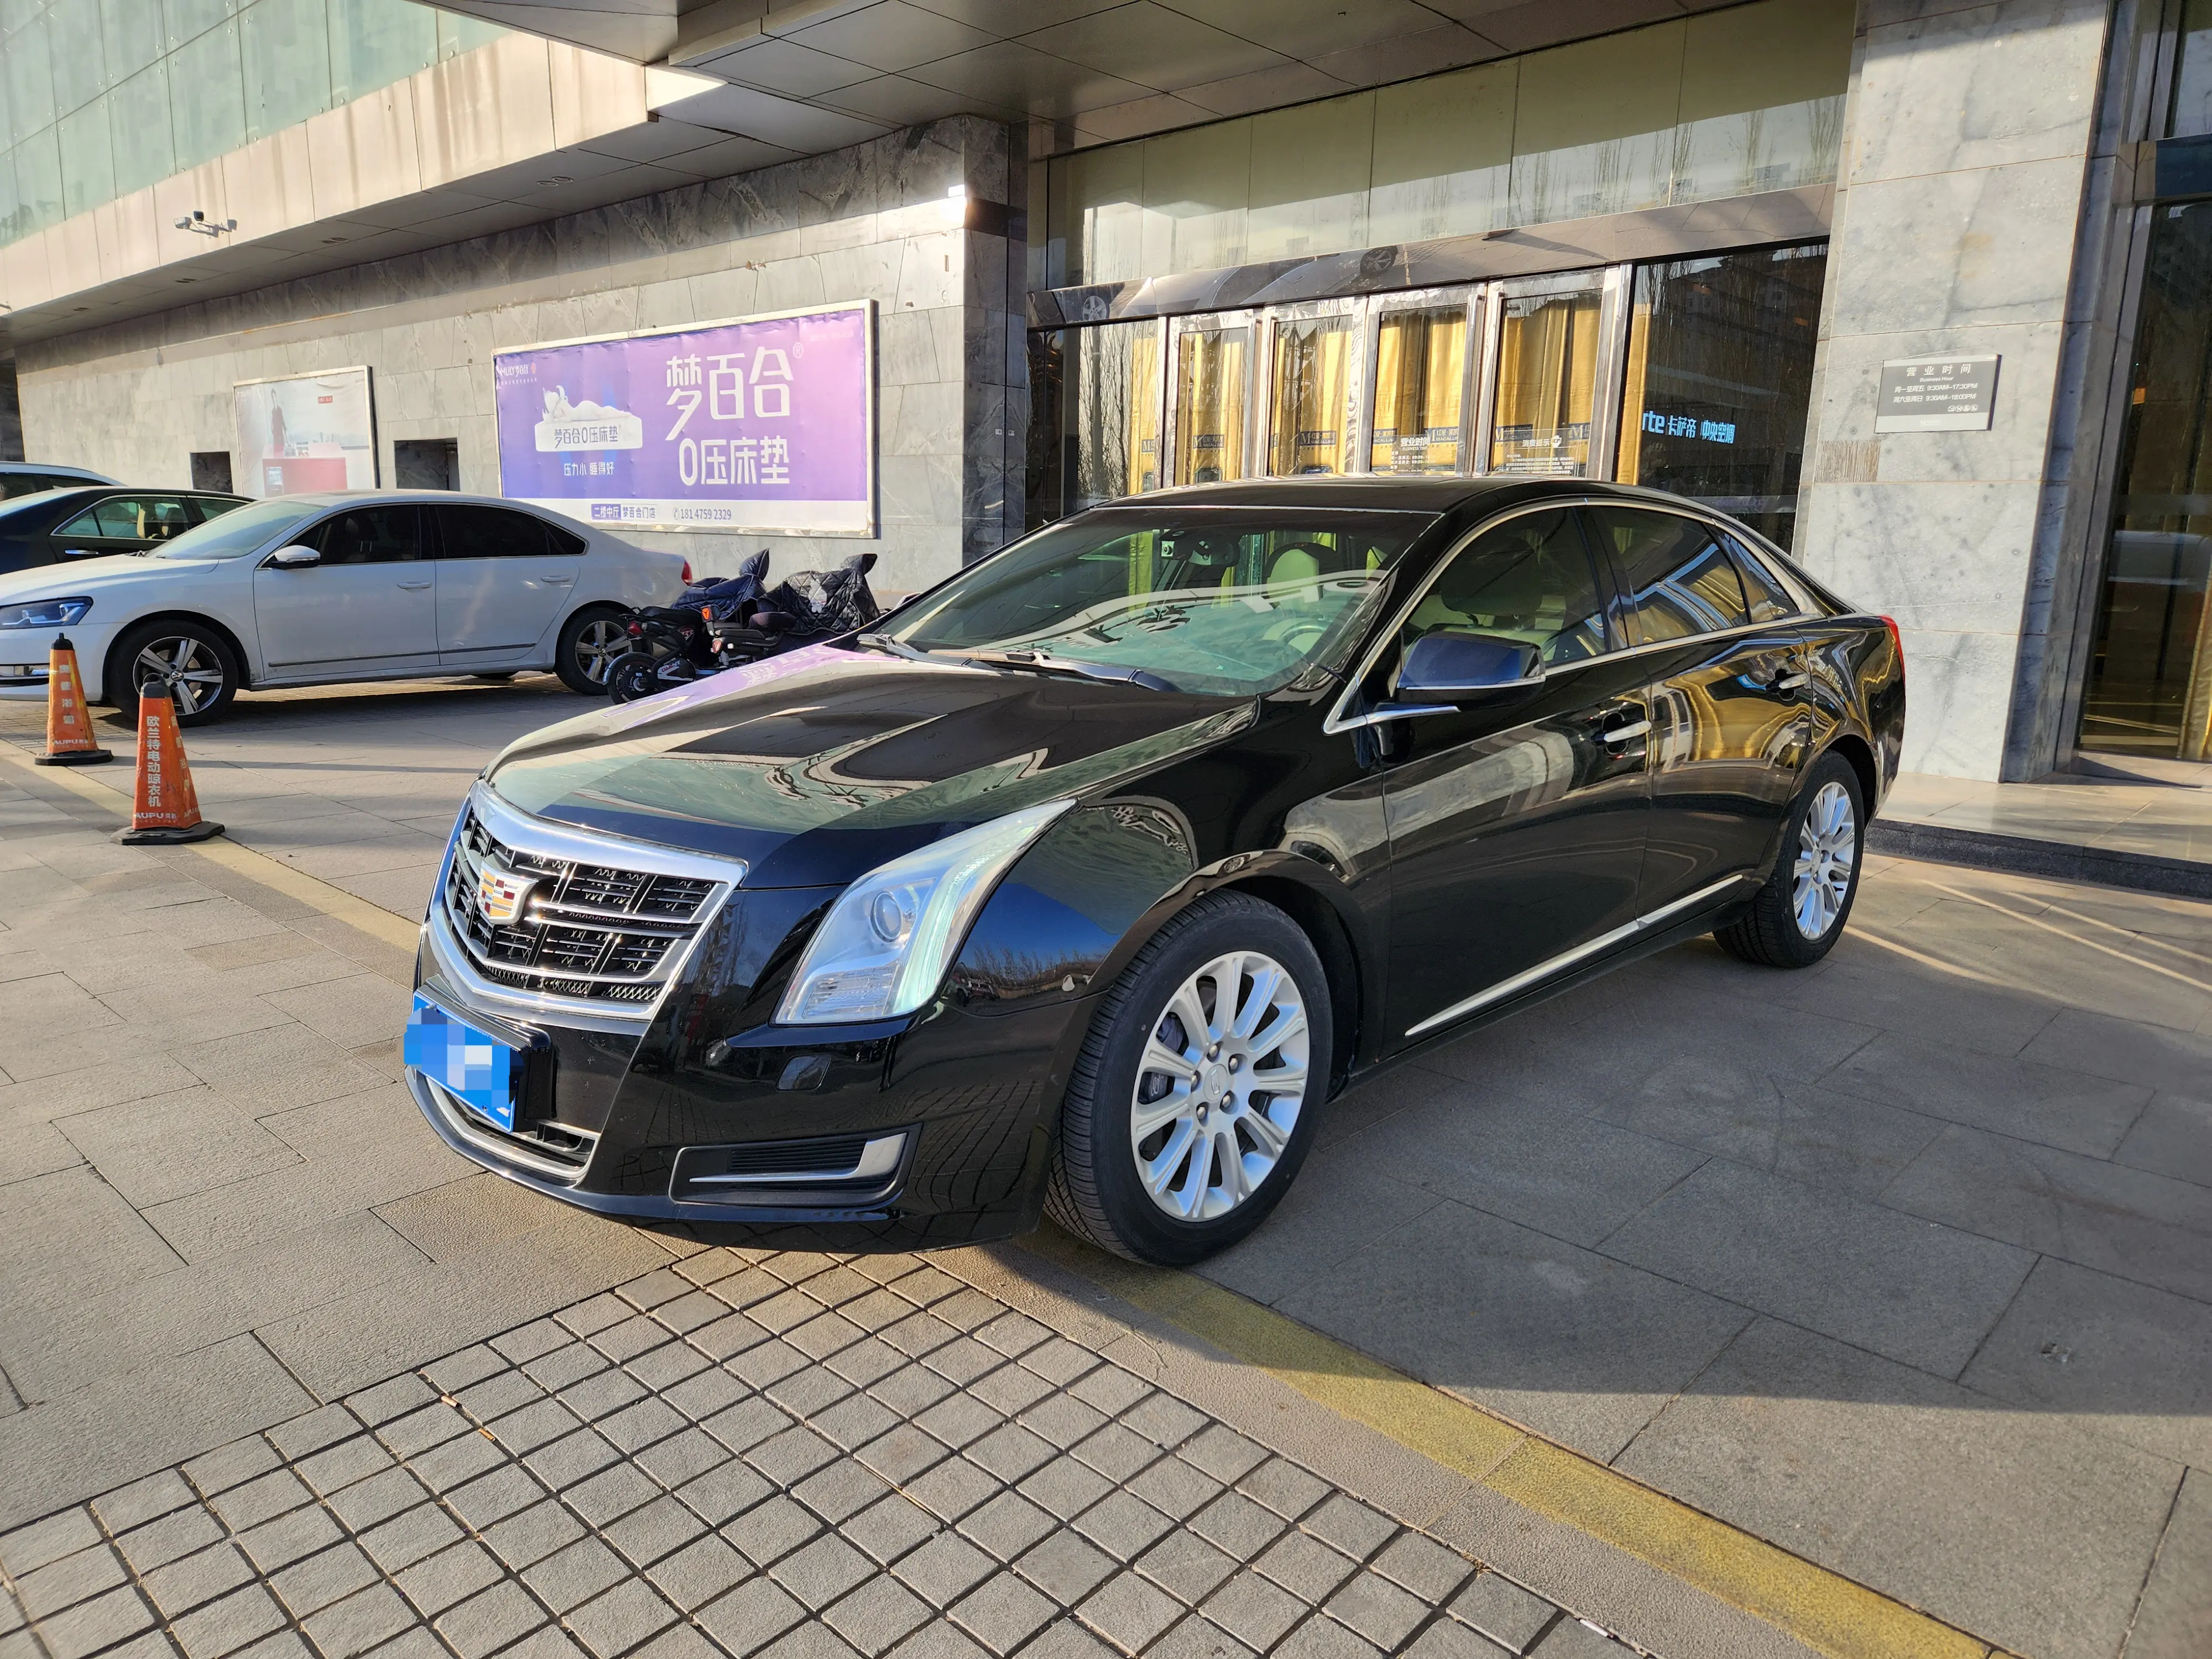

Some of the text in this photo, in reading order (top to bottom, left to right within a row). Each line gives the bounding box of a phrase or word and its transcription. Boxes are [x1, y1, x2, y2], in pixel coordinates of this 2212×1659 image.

[1907, 364, 1971, 377] 营业时间
[665, 346, 794, 441] 梦百合
[554, 425, 618, 448] 梦百合0压床垫
[1668, 415, 1697, 439] 卡萨帝
[1700, 420, 1735, 444] 中央空调
[1401, 437, 1431, 447] 营业时间
[679, 435, 790, 486] 0压床垫
[564, 462, 614, 476] 压力小 睡得好
[594, 507, 619, 518] 二楼中厅
[623, 507, 655, 518] 梦百合门店
[681, 508, 731, 520] 181 4759 2329
[147, 716, 161, 807] 欧兰特电动晾衣机
